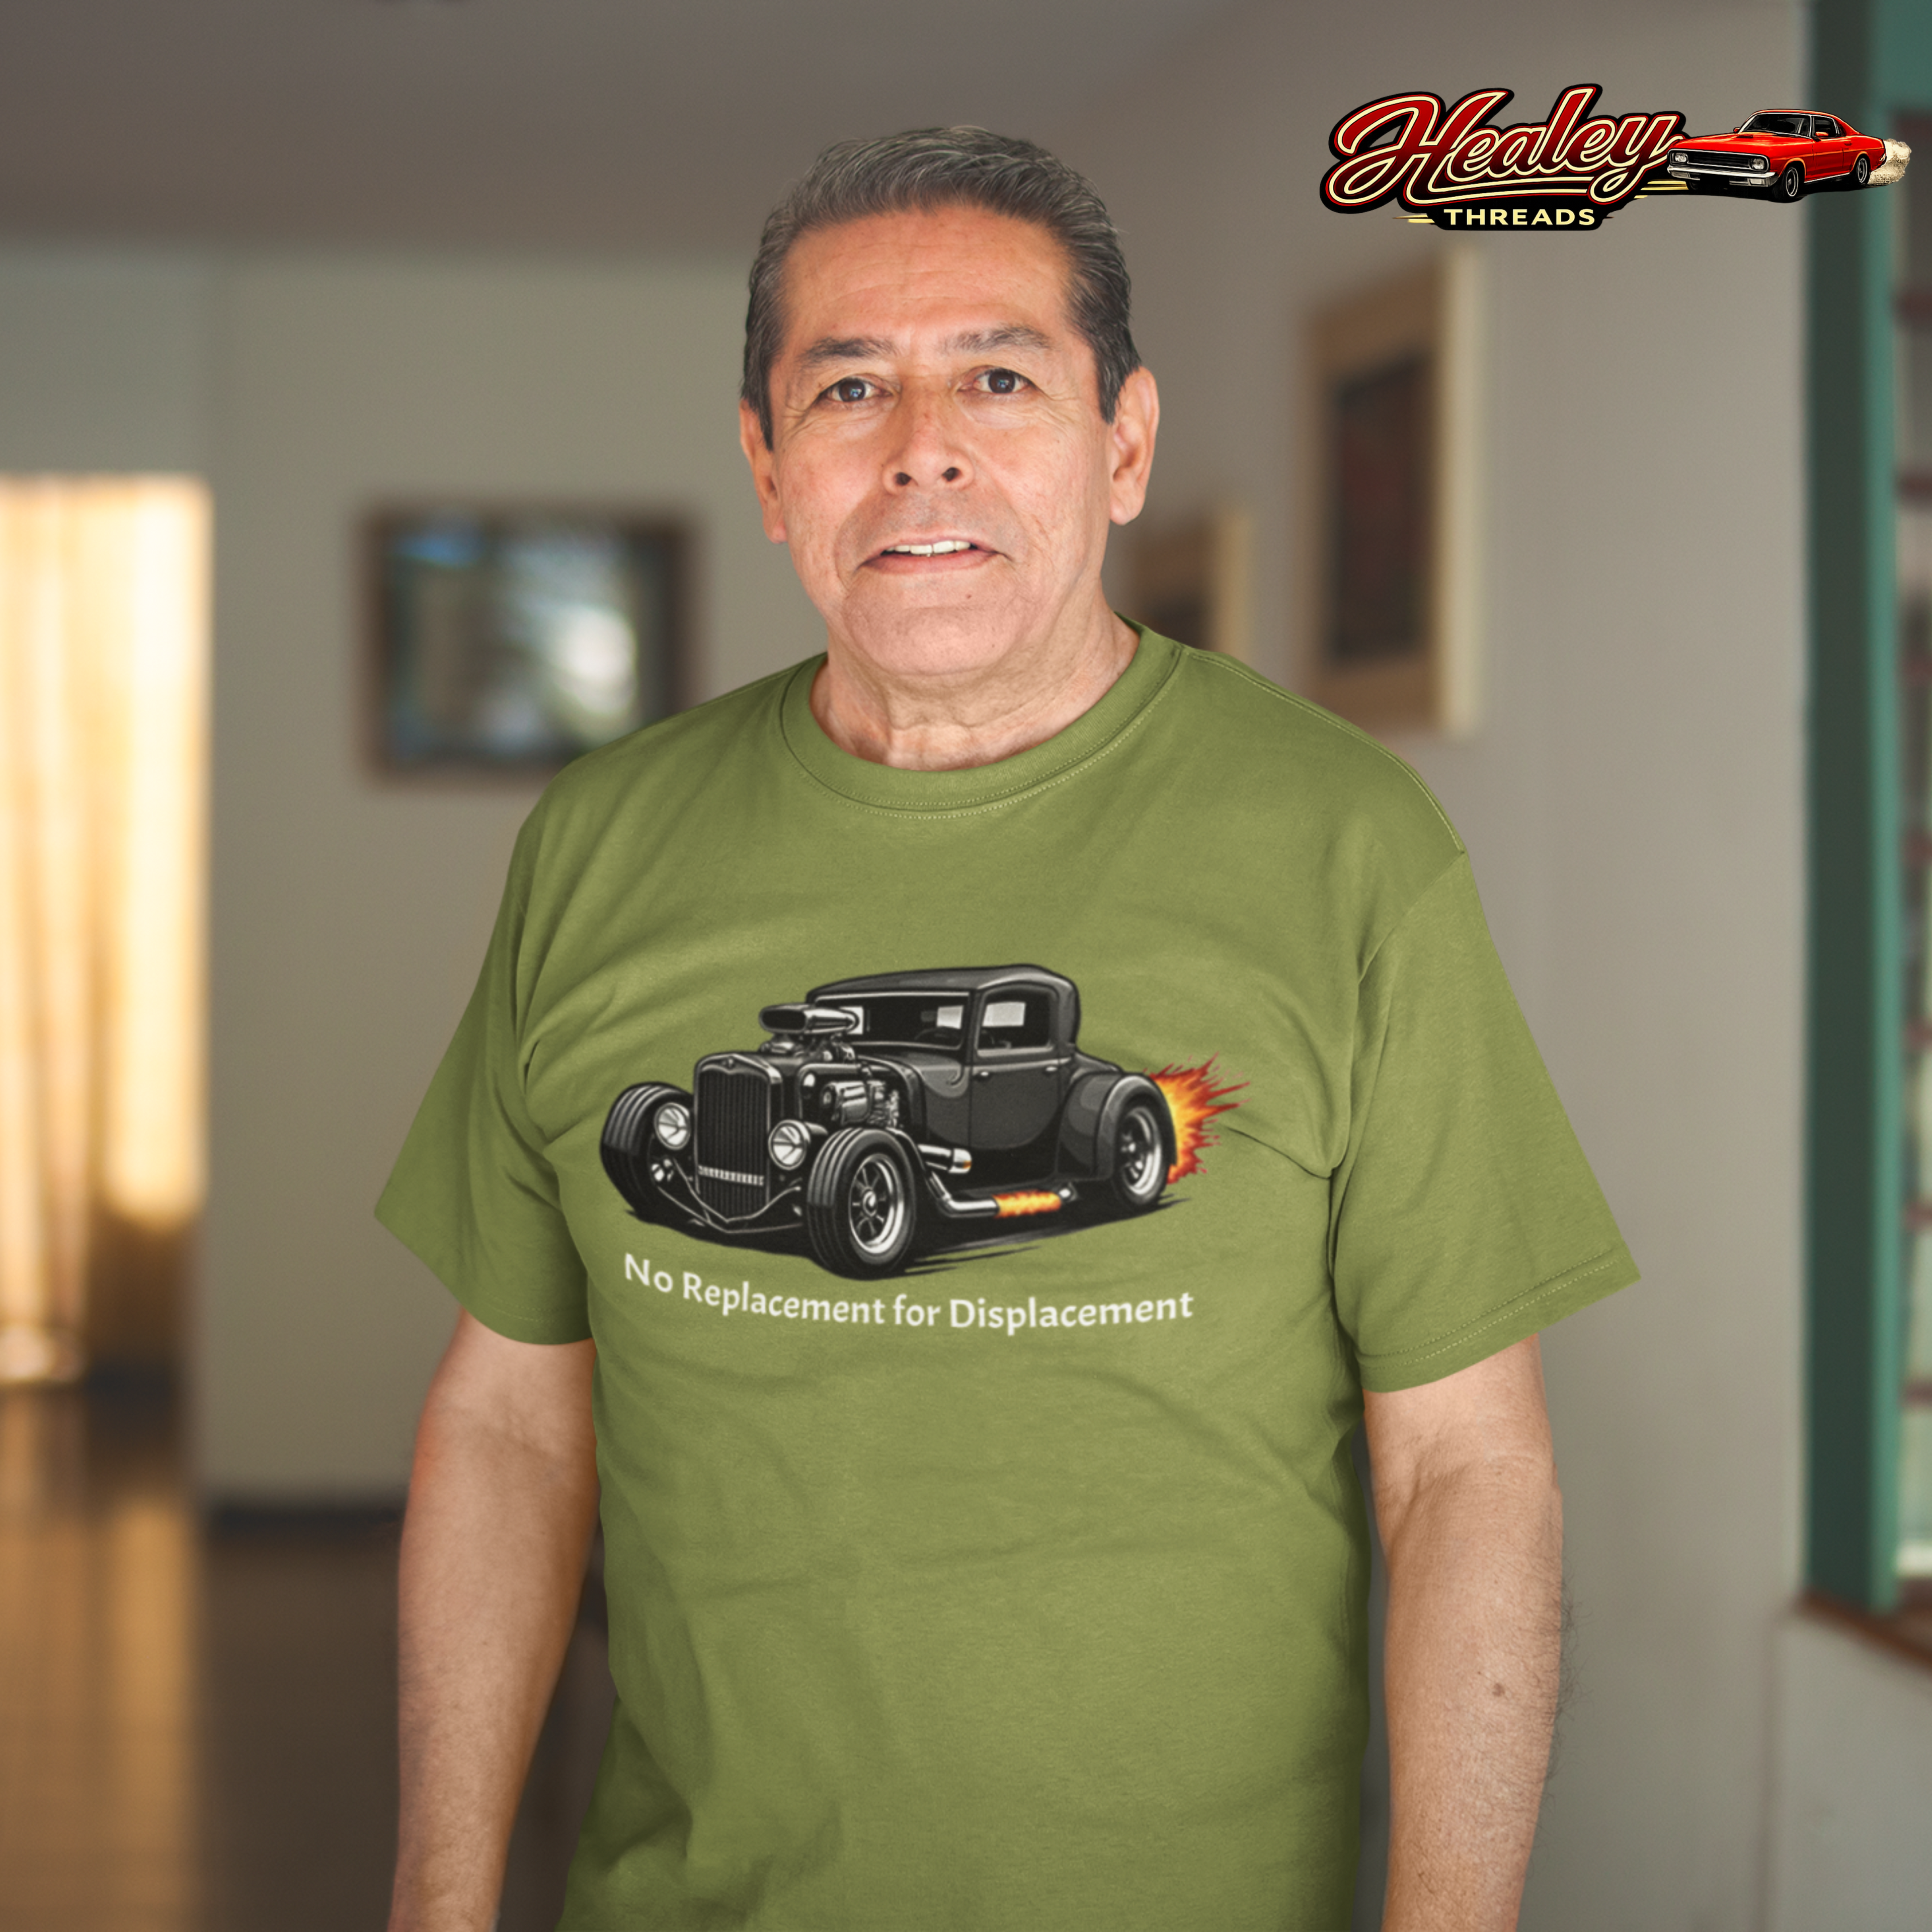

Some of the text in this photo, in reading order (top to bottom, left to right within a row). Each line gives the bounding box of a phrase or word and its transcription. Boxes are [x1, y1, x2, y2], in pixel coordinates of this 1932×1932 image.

[624, 1252, 1194, 1337] No Replacement for Displacement
